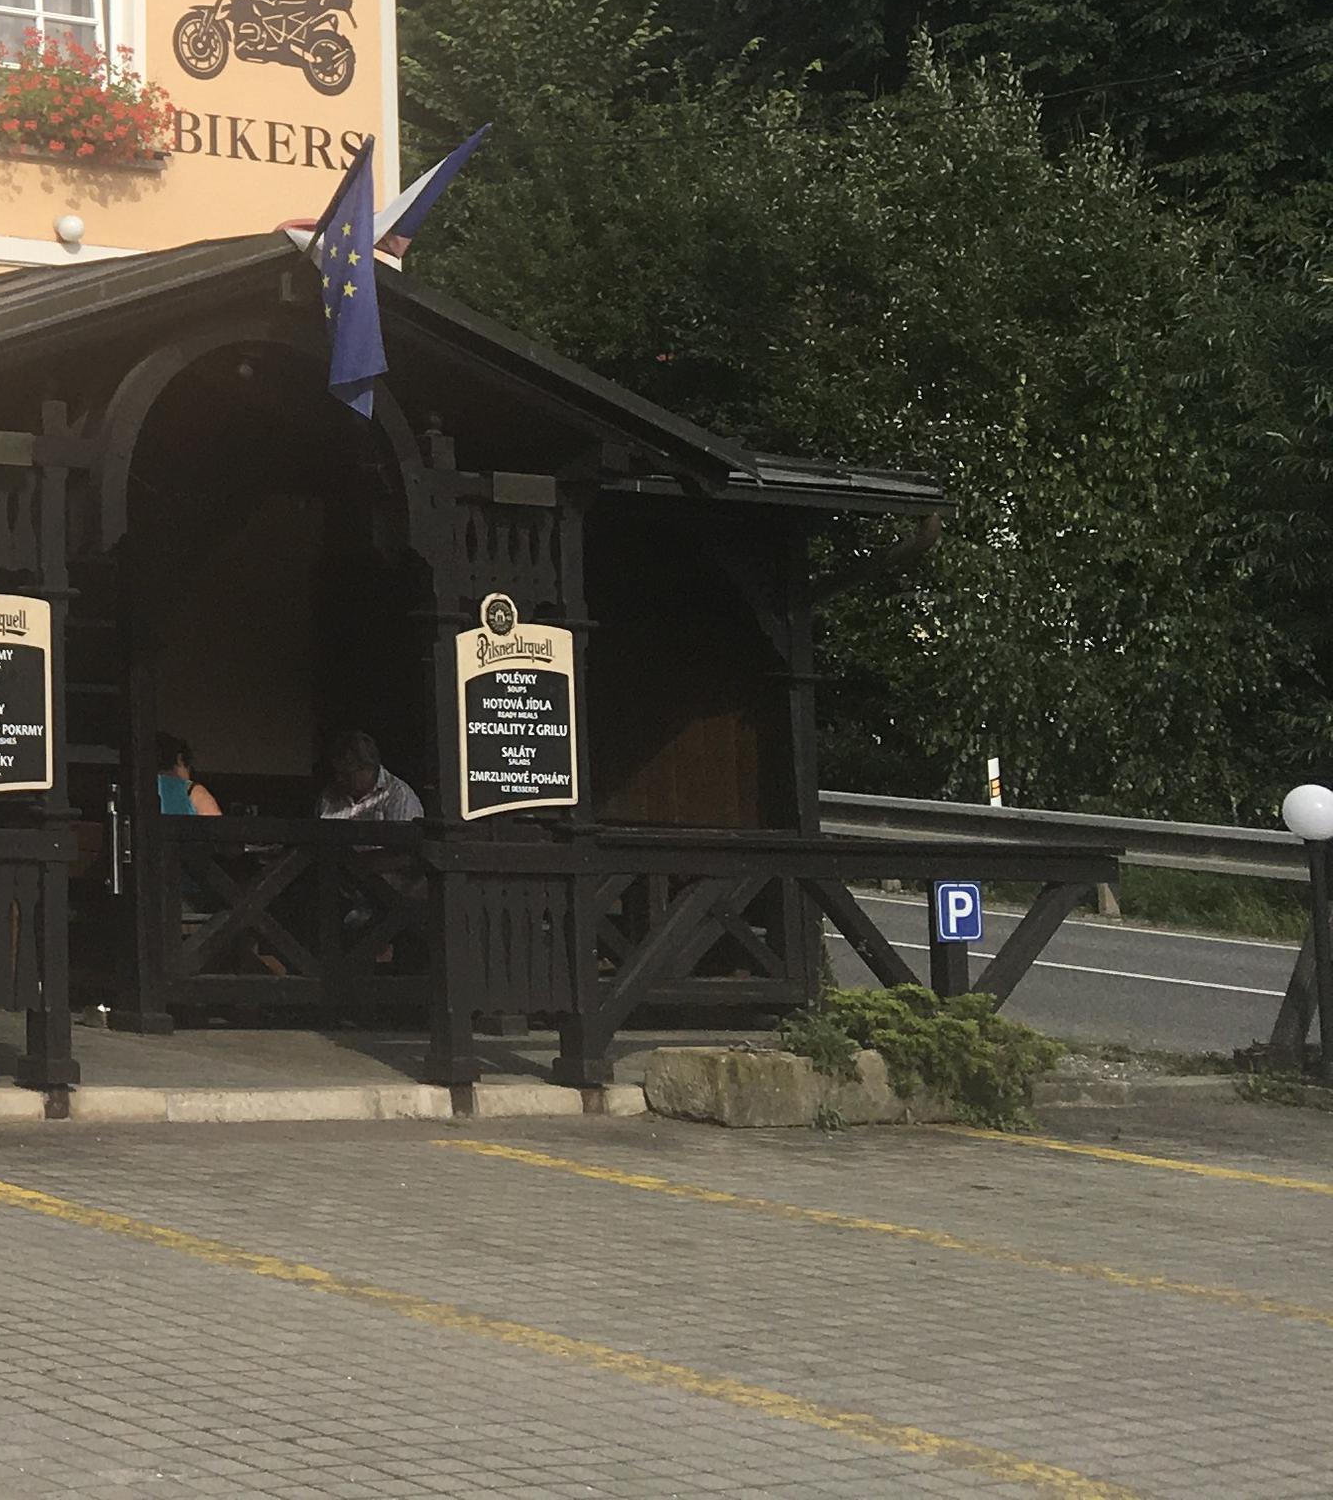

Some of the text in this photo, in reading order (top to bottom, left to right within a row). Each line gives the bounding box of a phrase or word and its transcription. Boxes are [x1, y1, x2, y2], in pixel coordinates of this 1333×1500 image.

[172, 110, 366, 172] BIKERS
[476, 633, 553, 668] Pilsner Urquell
[495, 671, 537, 685] POLÉVKY
[482, 696, 552, 711] HOTOVÁ JÍDLA
[2, 724, 44, 736] POKRMY
[468, 722, 568, 737] SPECIALITY Z GRILU
[501, 745, 537, 758] SALÁTY
[469, 771, 570, 785] ZMRZLINOVÉ POHÁRY
[948, 891, 974, 934] P
